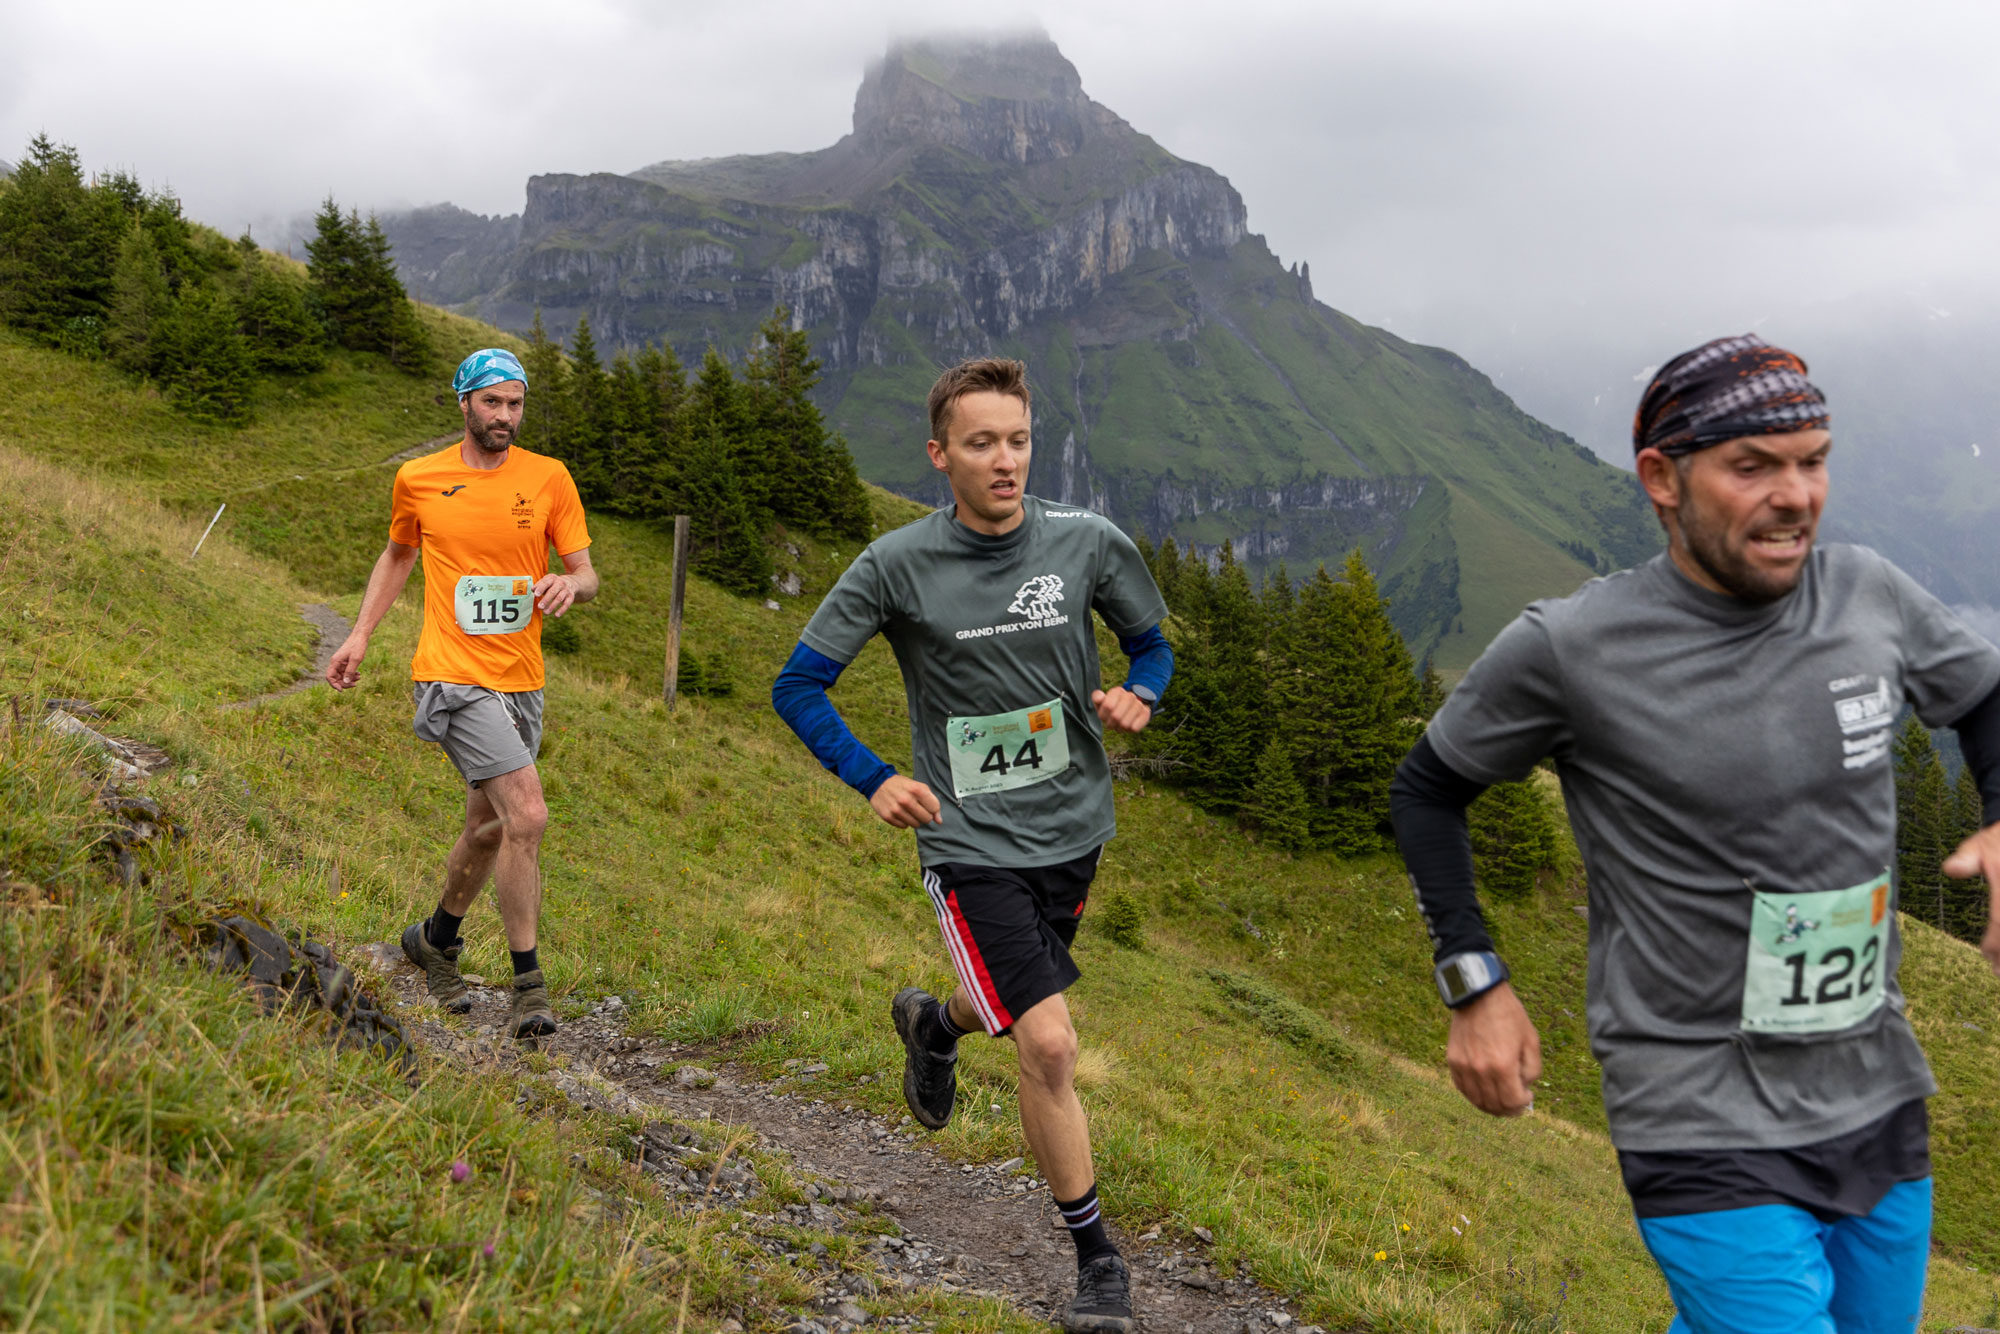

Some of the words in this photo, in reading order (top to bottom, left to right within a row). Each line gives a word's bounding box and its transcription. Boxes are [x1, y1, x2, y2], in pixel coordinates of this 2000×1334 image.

[1045, 510, 1082, 518] CRAFT
[473, 598, 519, 624] 115
[955, 626, 994, 640] GRAND
[995, 622, 1019, 634] PRIX
[1019, 619, 1042, 631] VON
[1043, 614, 1069, 628] BERN
[980, 738, 1044, 776] 44
[1780, 934, 1879, 1006] 122
